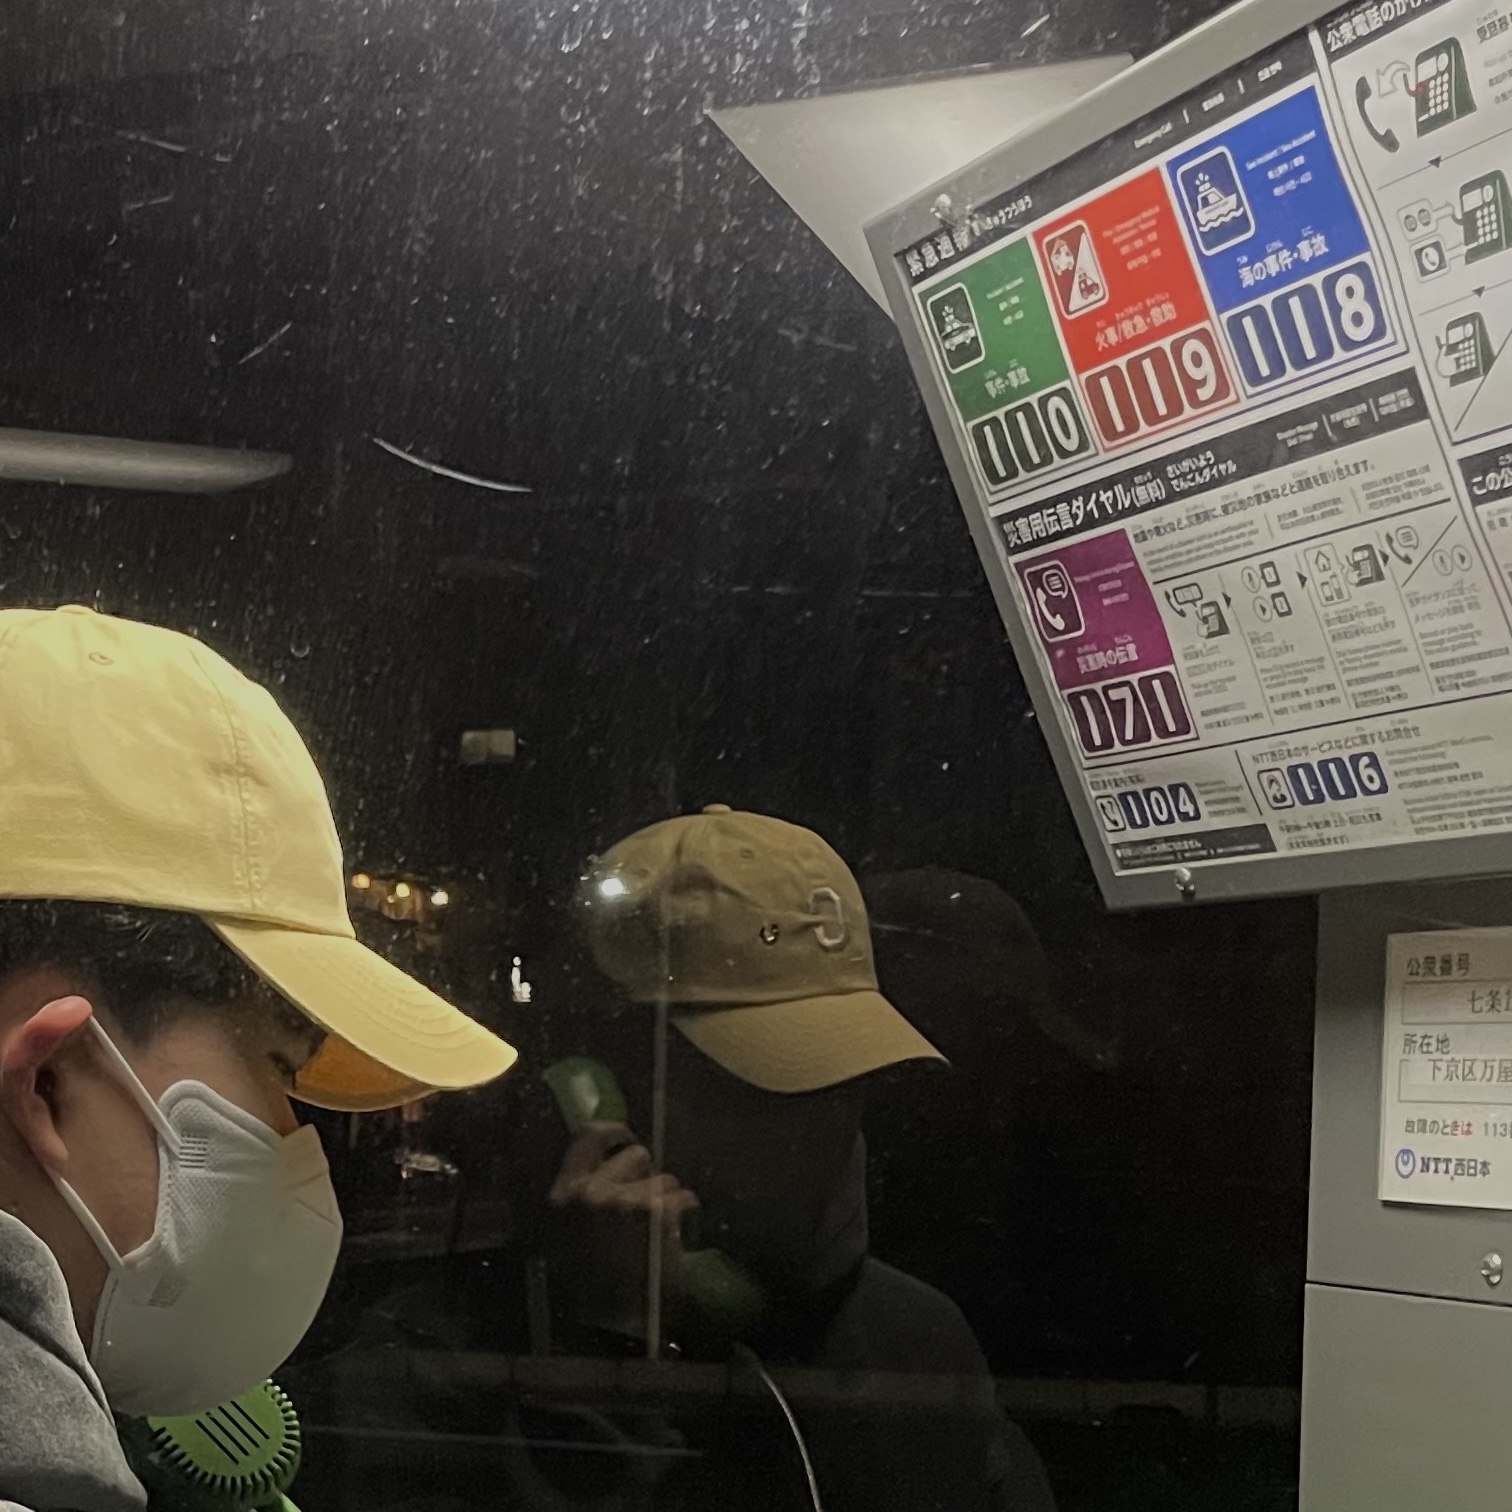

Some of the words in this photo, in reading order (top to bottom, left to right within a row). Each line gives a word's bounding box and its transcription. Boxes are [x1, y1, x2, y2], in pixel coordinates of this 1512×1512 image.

[1241, 273, 1375, 378] 118
[1099, 338, 1217, 432] 119
[983, 396, 1080, 478] 110
[1080, 679, 1177, 746] 171
[1296, 755, 1382, 801] 116
[1126, 786, 1195, 826] 104
[1402, 1032, 1451, 1055] 所在地
[1483, 1120, 1512, 1139] 113
[1420, 1156, 1491, 1177] NTT西日本
